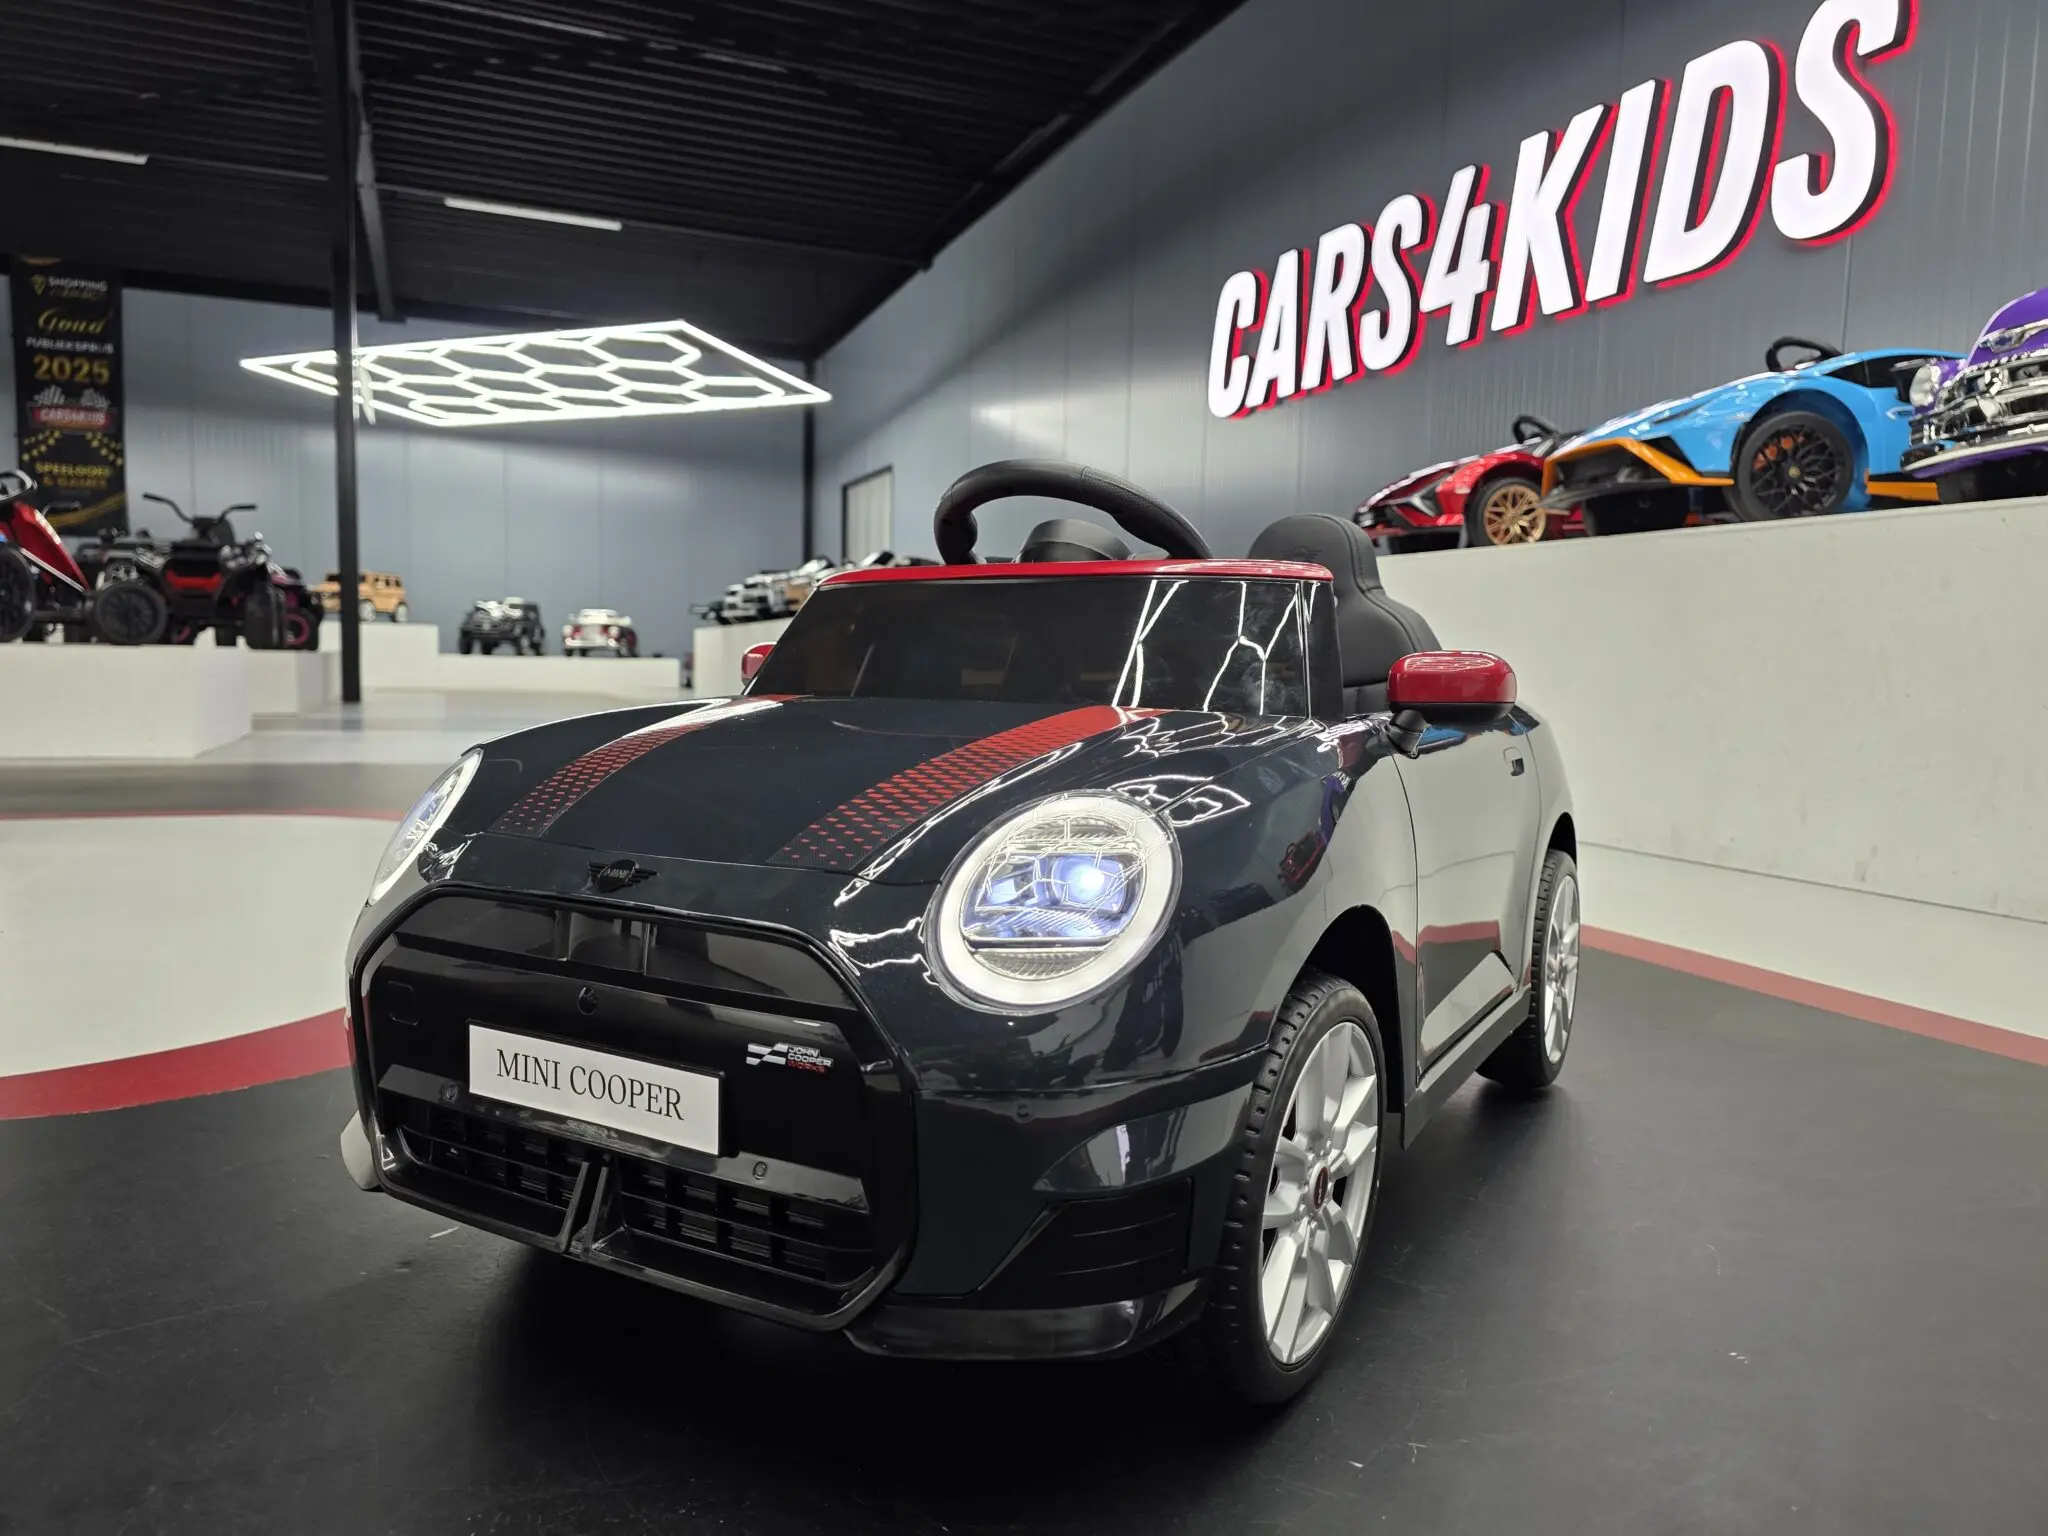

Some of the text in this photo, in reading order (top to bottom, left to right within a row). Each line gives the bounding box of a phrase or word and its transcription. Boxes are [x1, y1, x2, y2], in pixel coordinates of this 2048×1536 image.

[1207, 0, 1906, 419] CARS4KIDS
[33, 354, 110, 385] 2025
[787, 1053, 832, 1067] COOPER
[788, 1046, 819, 1058] JOHN
[496, 1048, 685, 1121] MINI COOPER
